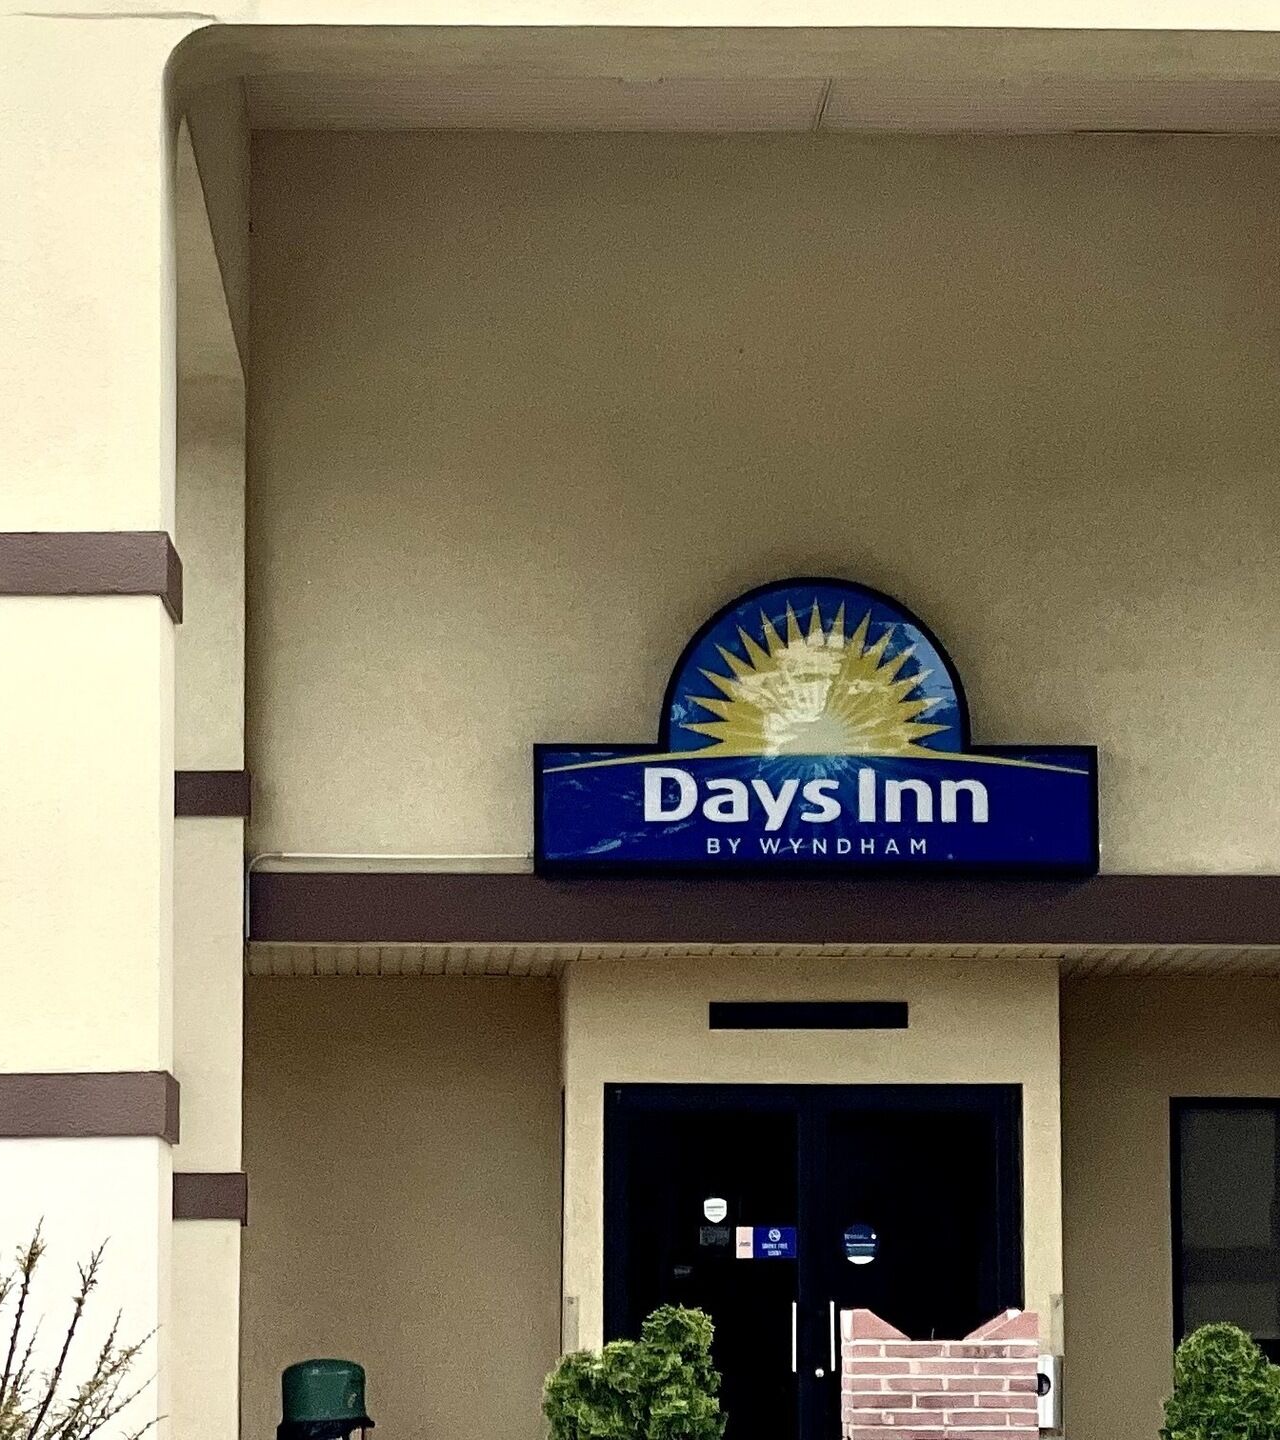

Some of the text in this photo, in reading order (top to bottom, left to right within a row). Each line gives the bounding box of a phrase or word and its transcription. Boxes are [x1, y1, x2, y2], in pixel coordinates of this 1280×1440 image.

[643, 767, 988, 830] Days Inn
[706, 838, 928, 854] BY WYNDHAM
